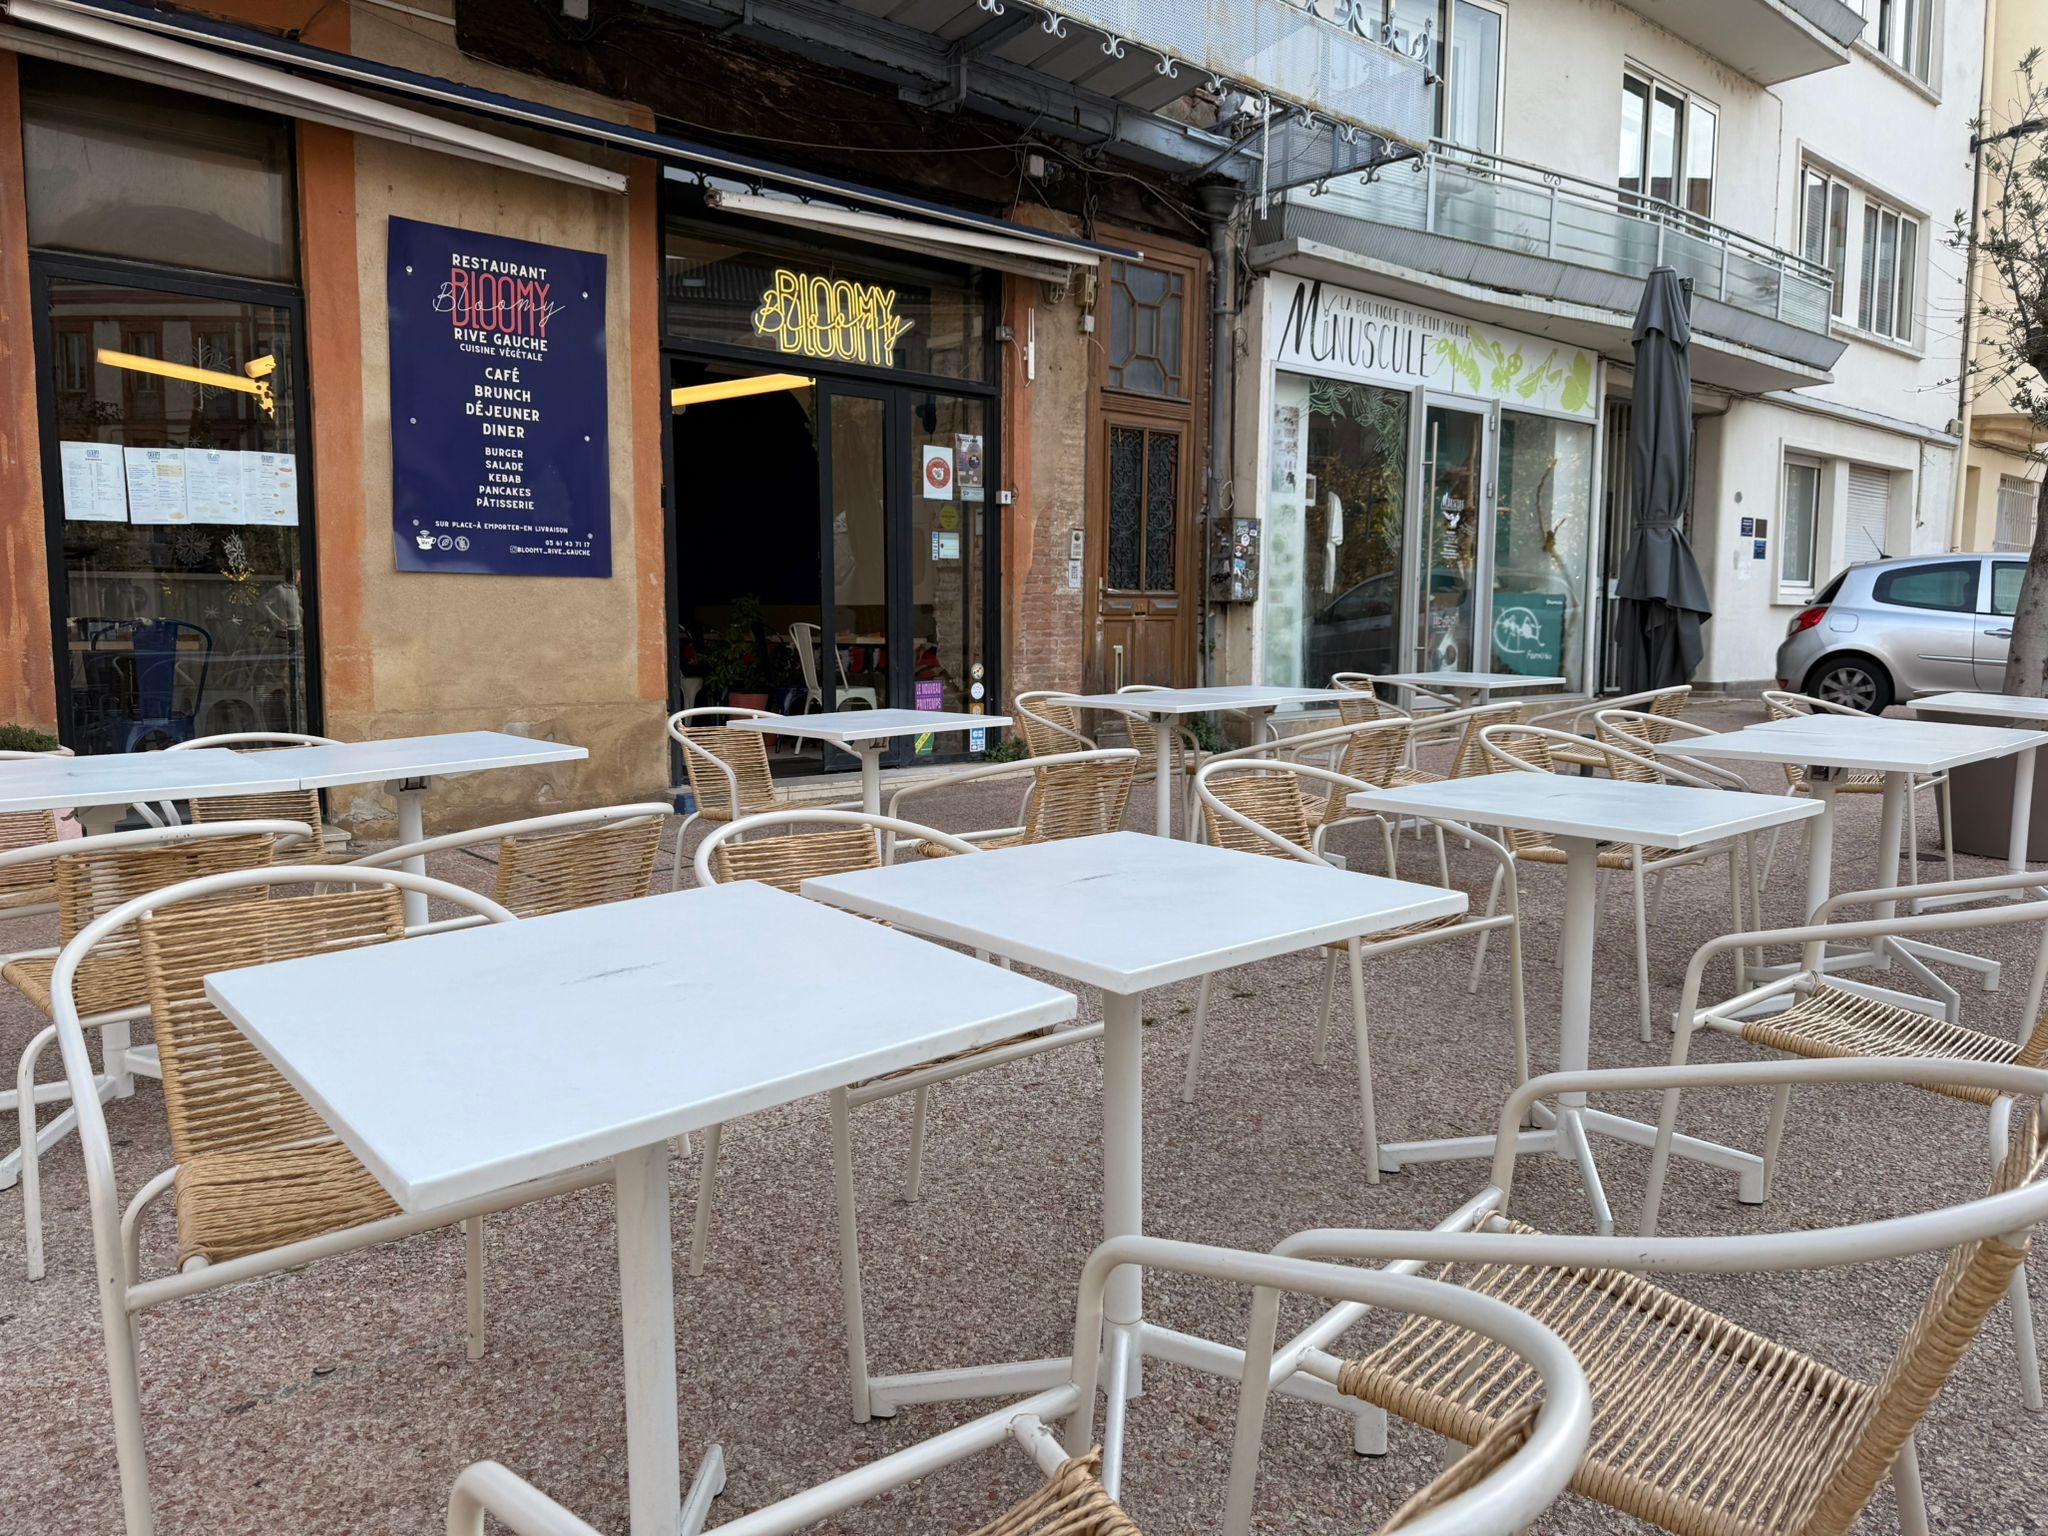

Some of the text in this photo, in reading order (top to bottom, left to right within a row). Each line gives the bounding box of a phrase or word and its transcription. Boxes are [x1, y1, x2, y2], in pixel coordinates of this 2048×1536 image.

[452, 253, 547, 281] RESTAURANT
[433, 281, 566, 328] Bloomy
[451, 268, 550, 338] BLOOMY
[755, 289, 913, 350] Bloomy
[775, 269, 896, 366] BLOOMY
[1341, 295, 1471, 340] LA BOUTIQUE DU PETIT MONDE
[454, 328, 548, 351] RIVE GAUCHE
[459, 343, 543, 362] CUISINE VÉGÉTALE
[485, 367, 520, 383] CAFÉ
[474, 384, 531, 403] BRUNCH
[465, 400, 540, 422] DÉJEUNER
[482, 423, 525, 439] DINER
[485, 447, 524, 459] BURGER
[485, 460, 524, 472] SALADE
[488, 473, 521, 484] KEBAB
[478, 485, 531, 497] PANCAKES
[476, 497, 535, 510] PÂTISSERIE
[435, 520, 449, 528] SUR
[535, 526, 568, 534] LIVRAISON
[916, 682, 941, 695] LE NOUVEAU
[917, 697, 941, 710] PRINTEMPS
